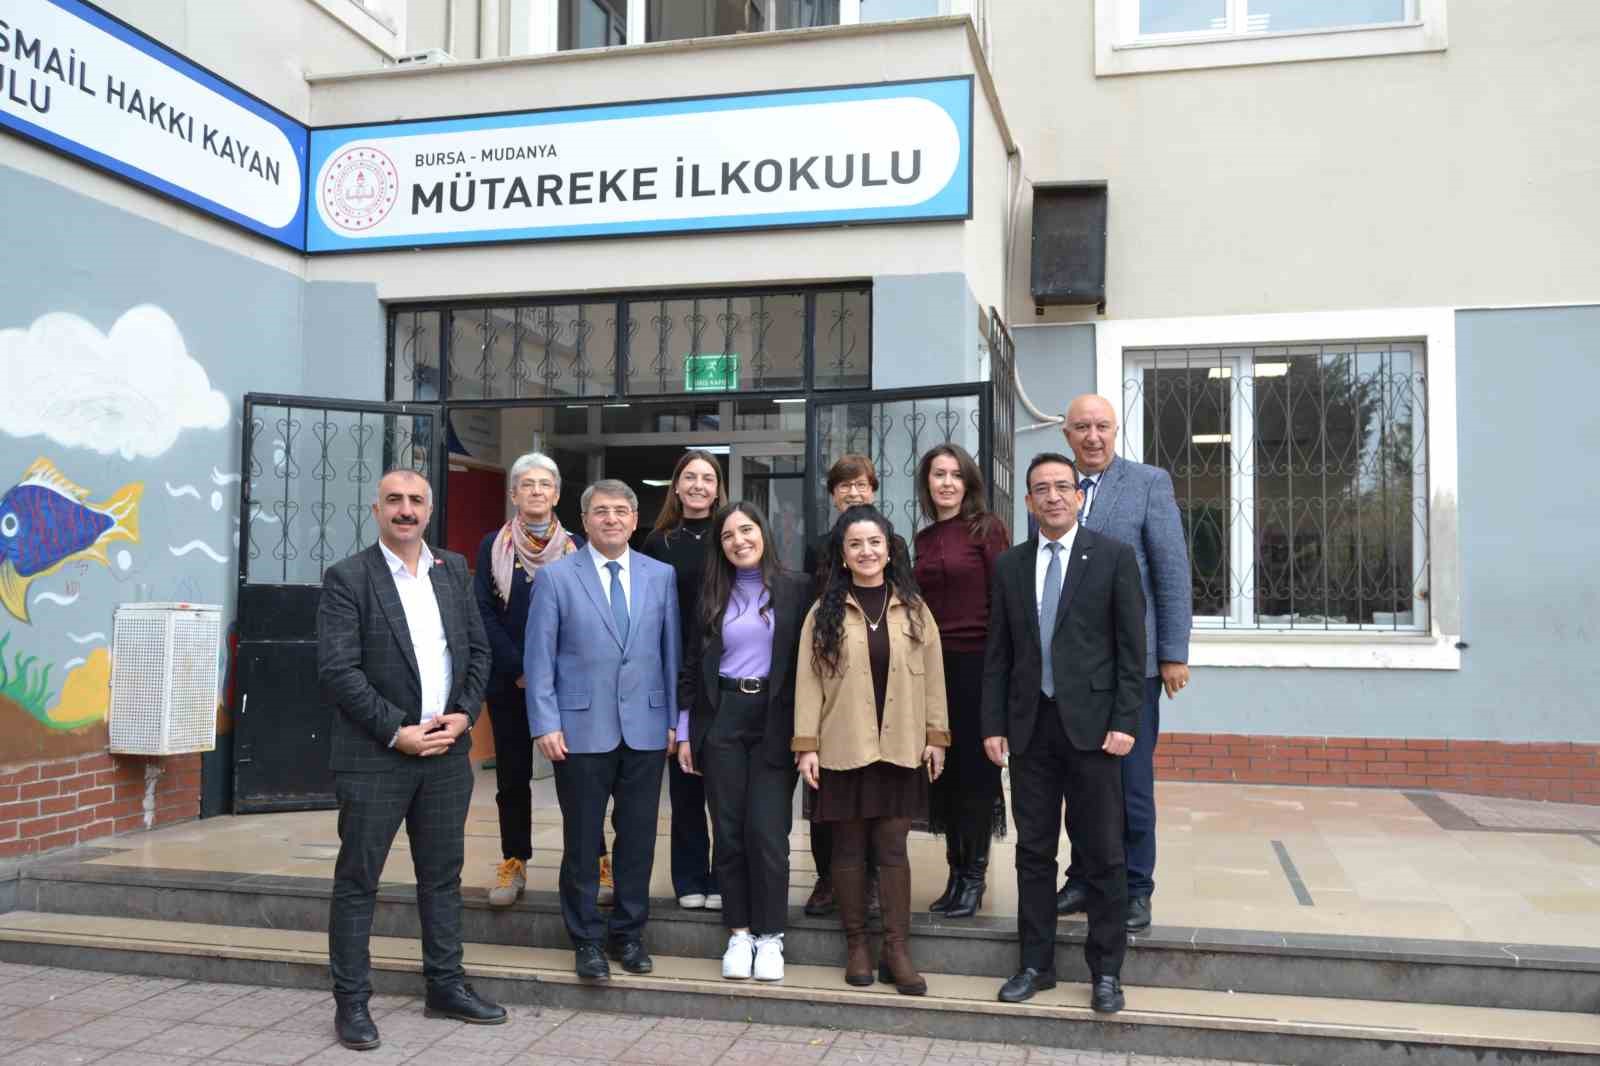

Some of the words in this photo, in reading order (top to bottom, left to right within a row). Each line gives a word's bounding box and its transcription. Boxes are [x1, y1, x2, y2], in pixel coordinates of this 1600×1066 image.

[0, 64, 51, 114] LU
[106, 74, 193, 143] HAKKI
[203, 124, 280, 186] KAYAN
[415, 151, 467, 168] BURSA
[481, 144, 558, 162] MUDANYA
[411, 168, 658, 215] MÜTAREKE
[675, 149, 922, 198] İLKOKULU
